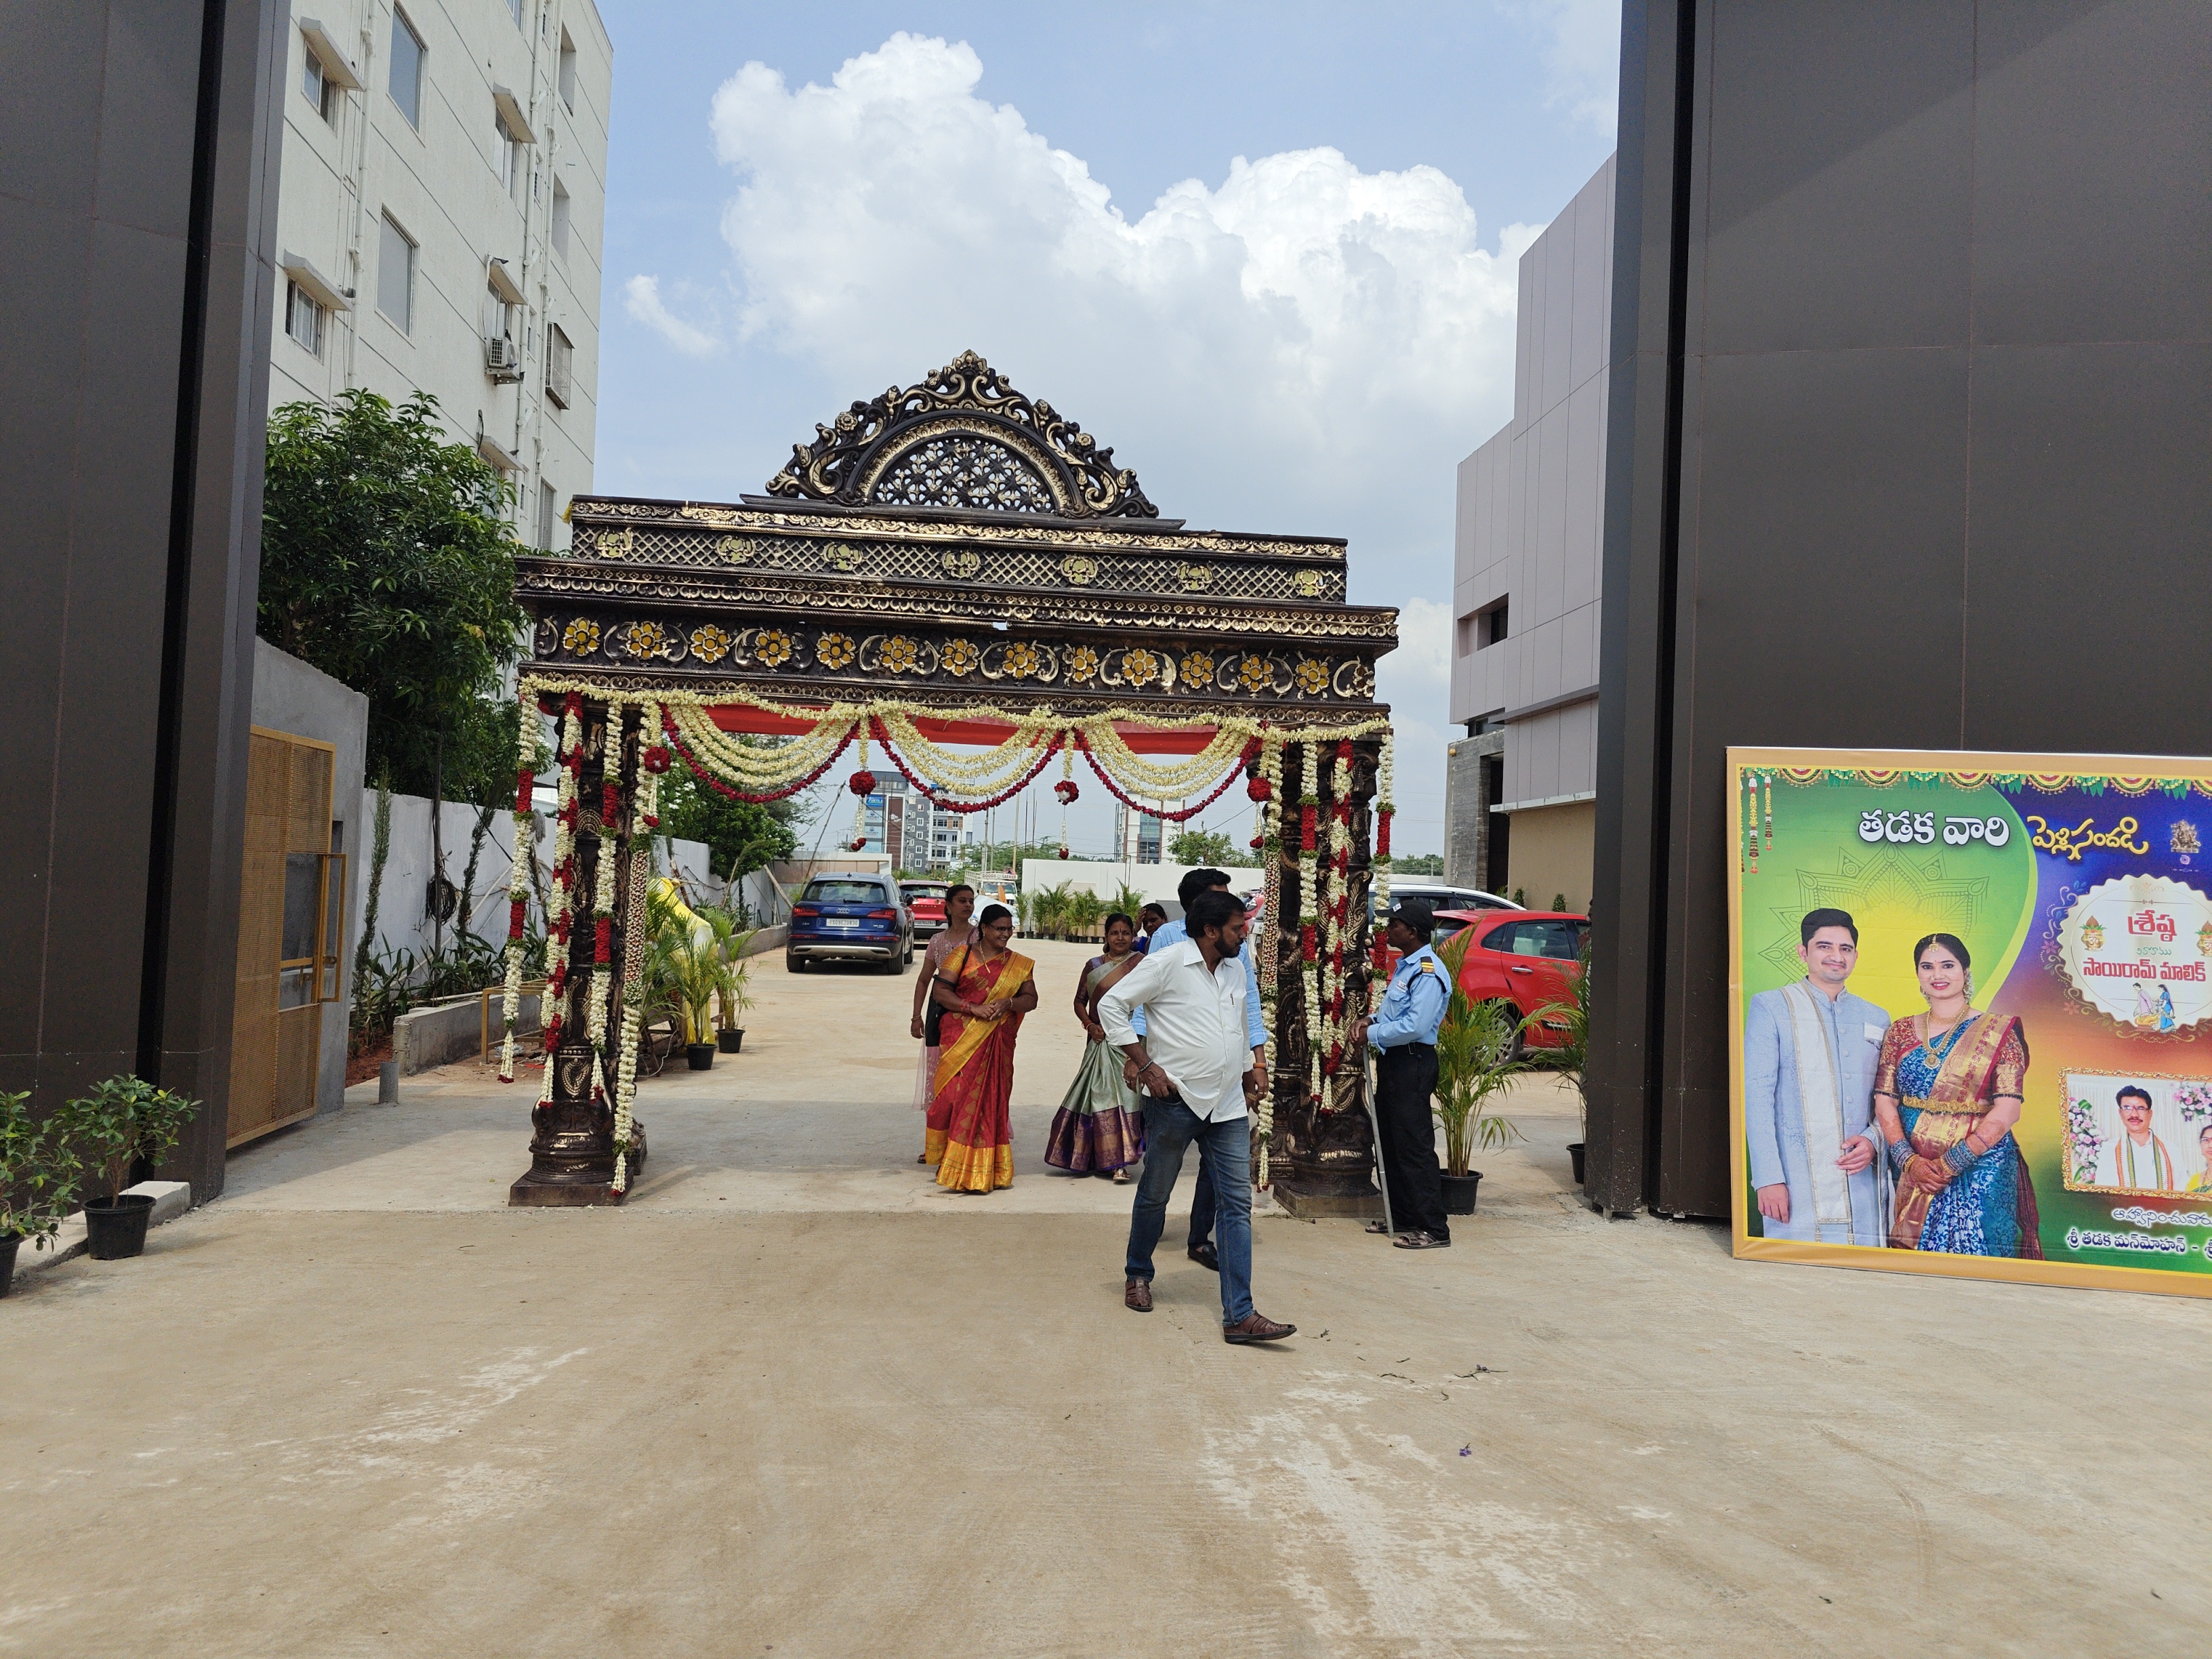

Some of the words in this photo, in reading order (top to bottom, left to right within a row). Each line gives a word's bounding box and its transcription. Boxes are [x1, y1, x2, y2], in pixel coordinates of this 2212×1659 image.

[1858, 808, 1936, 844] తడక
[1942, 816, 2011, 847] వారి
[2159, 961, 2207, 982] మాలిక్
[2067, 1228, 2080, 1248] శ్రీ
[2082, 1231, 2112, 1247] తడక
